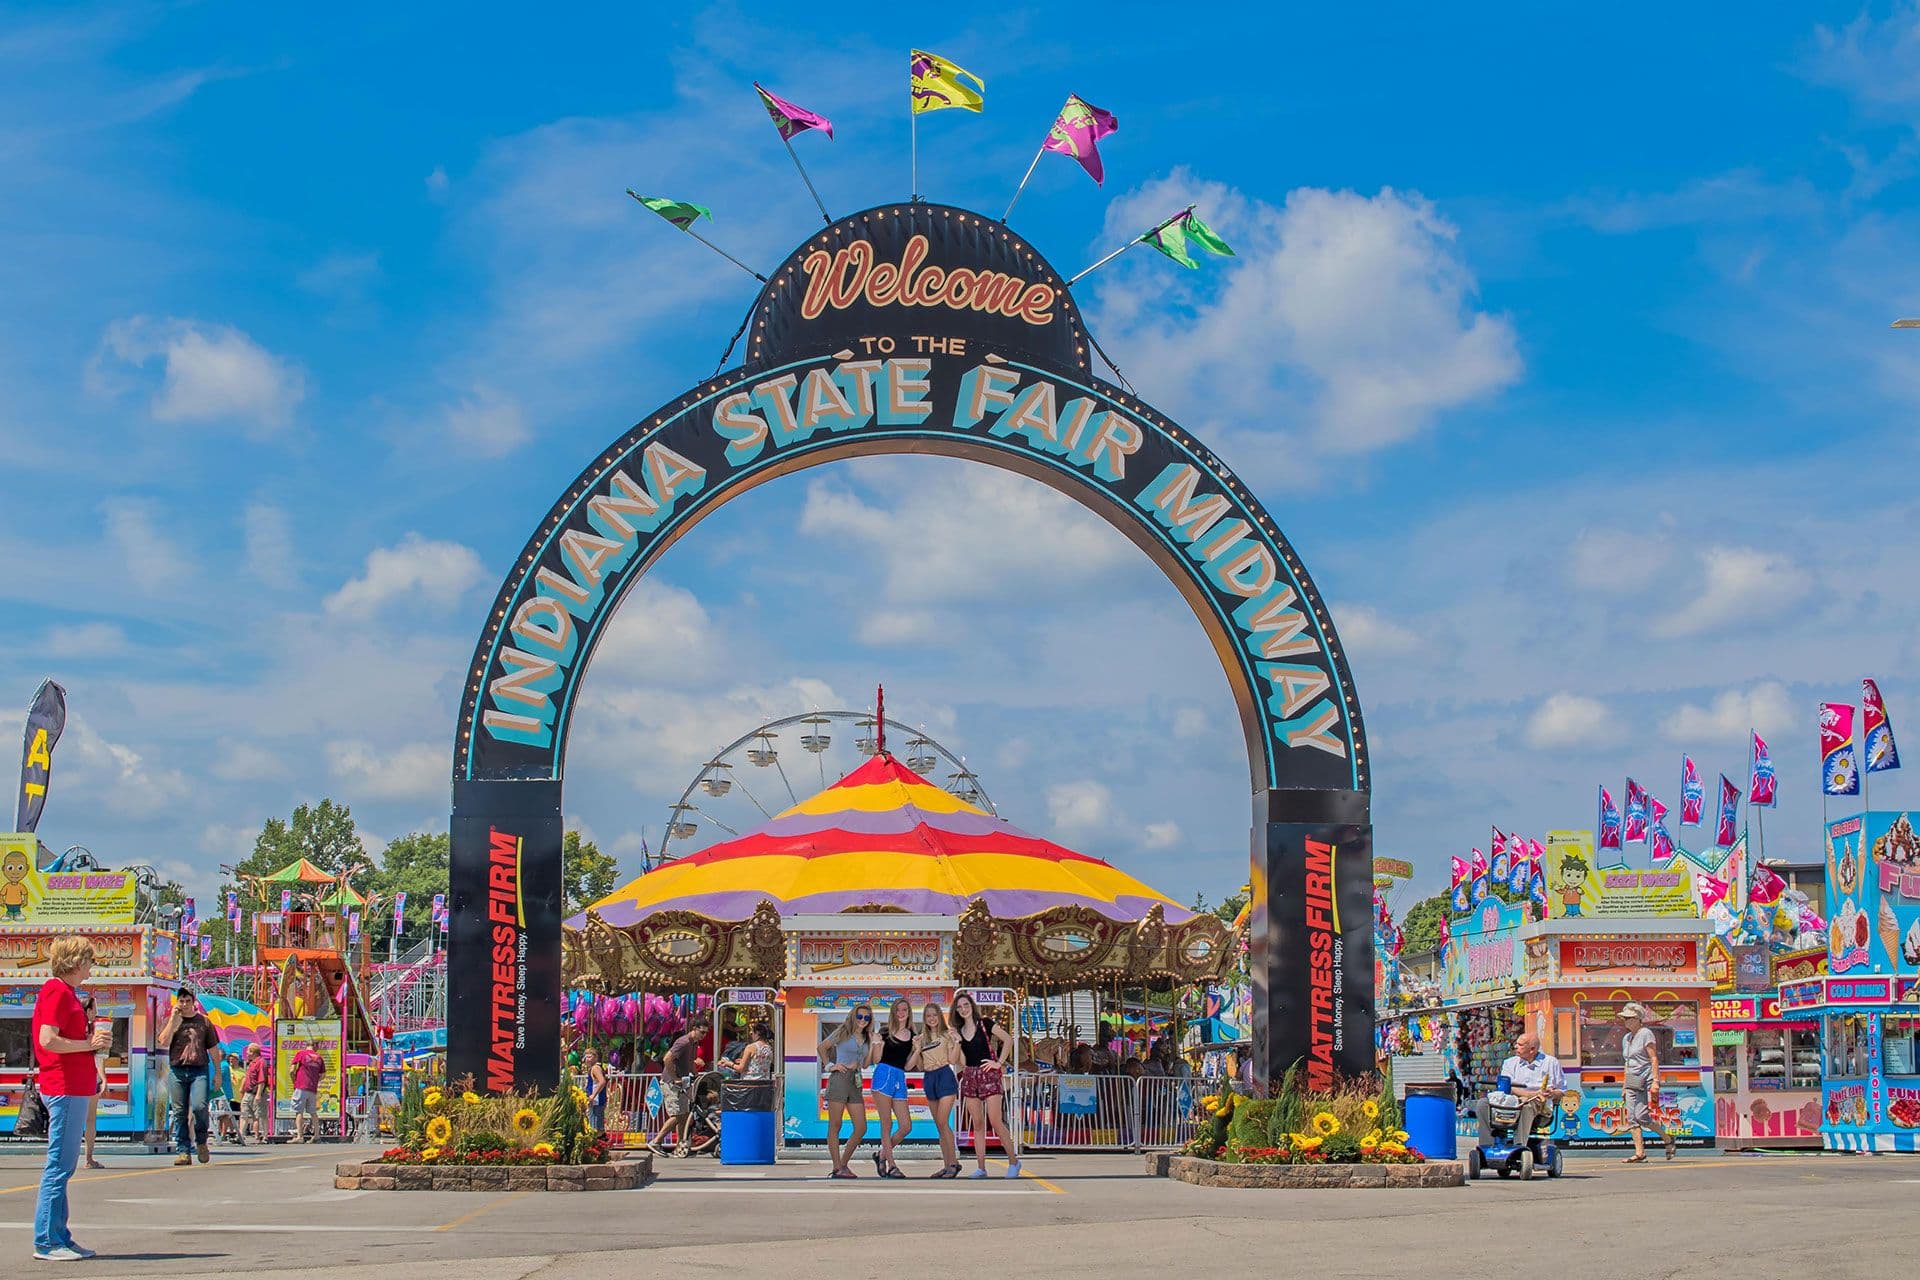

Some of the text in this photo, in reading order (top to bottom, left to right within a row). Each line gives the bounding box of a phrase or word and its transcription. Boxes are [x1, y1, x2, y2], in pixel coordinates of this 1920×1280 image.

[801, 234, 1055, 325] Welcome
[859, 336, 967, 356] TO THE
[483, 357, 1346, 759] INDIANA STATE FAIR MIDWAY
[48, 875, 83, 890] SIZE
[801, 942, 938, 966] RIDE COUPONS
[1574, 946, 1686, 968] RIDE COUPONS
[516, 931, 528, 1049] Save Money. Sleep Happy.
[738, 992, 764, 1000] ENTRANCE
[980, 992, 999, 1001] EXIT
[1334, 938, 1343, 1051] Save Money. Sleep Happy.
[1830, 984, 1853, 998] COLD
[1855, 984, 1886, 998] DRINKS
[1711, 1000, 1742, 1010] OLD
[316, 1040, 338, 1050] IZE
[1872, 1066, 1880, 1124] CONES
[1888, 1086, 1920, 1100] FUN
[1588, 1106, 1683, 1134] COUNS
